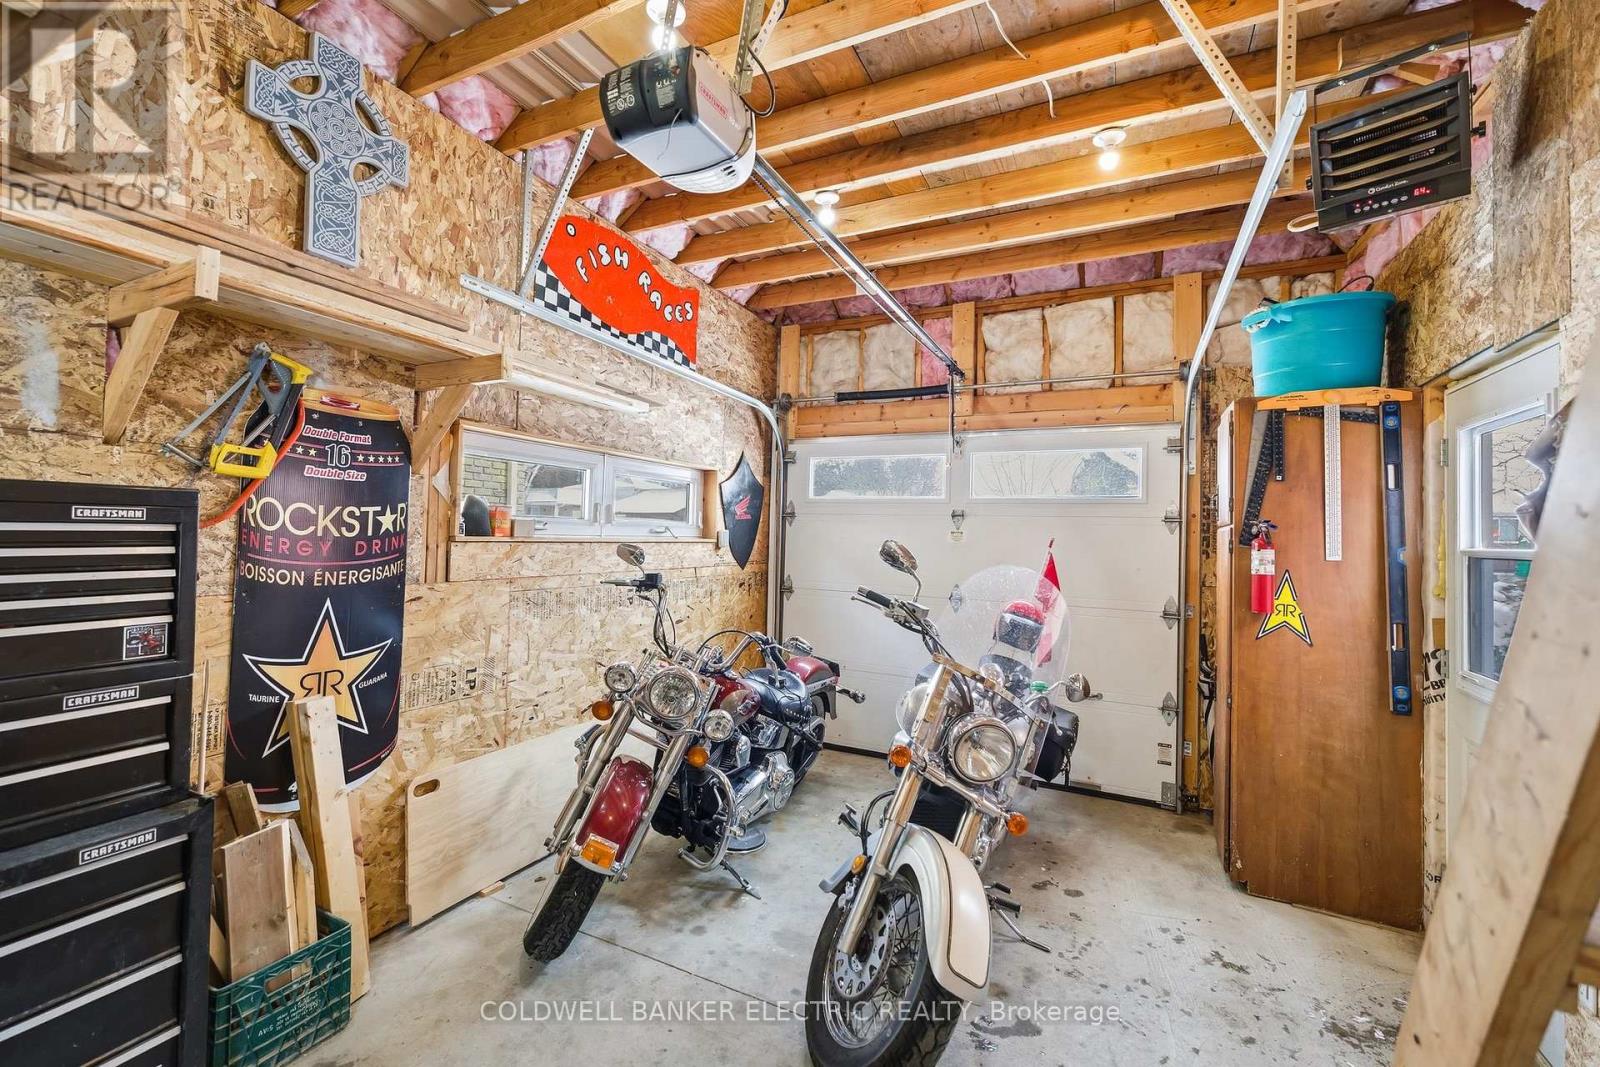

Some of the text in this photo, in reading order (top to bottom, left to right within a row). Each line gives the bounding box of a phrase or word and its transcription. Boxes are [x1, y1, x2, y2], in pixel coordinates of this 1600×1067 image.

[575, 243, 694, 323] FISH RACES
[303, 424, 372, 445] Double Format
[325, 443, 351, 468] 16
[304, 466, 367, 482] Double Size
[74, 507, 145, 519] CRAFTSMAN
[241, 527, 405, 557] ENERGY DRINK
[240, 557, 405, 587] BOISSON ÉNERGISANTE
[358, 671, 388, 689] GUARANA
[66, 687, 137, 709] CRAFTSMAN
[248, 693, 280, 703] TAURINE
[82, 831, 155, 862] CRAFTSMAN
